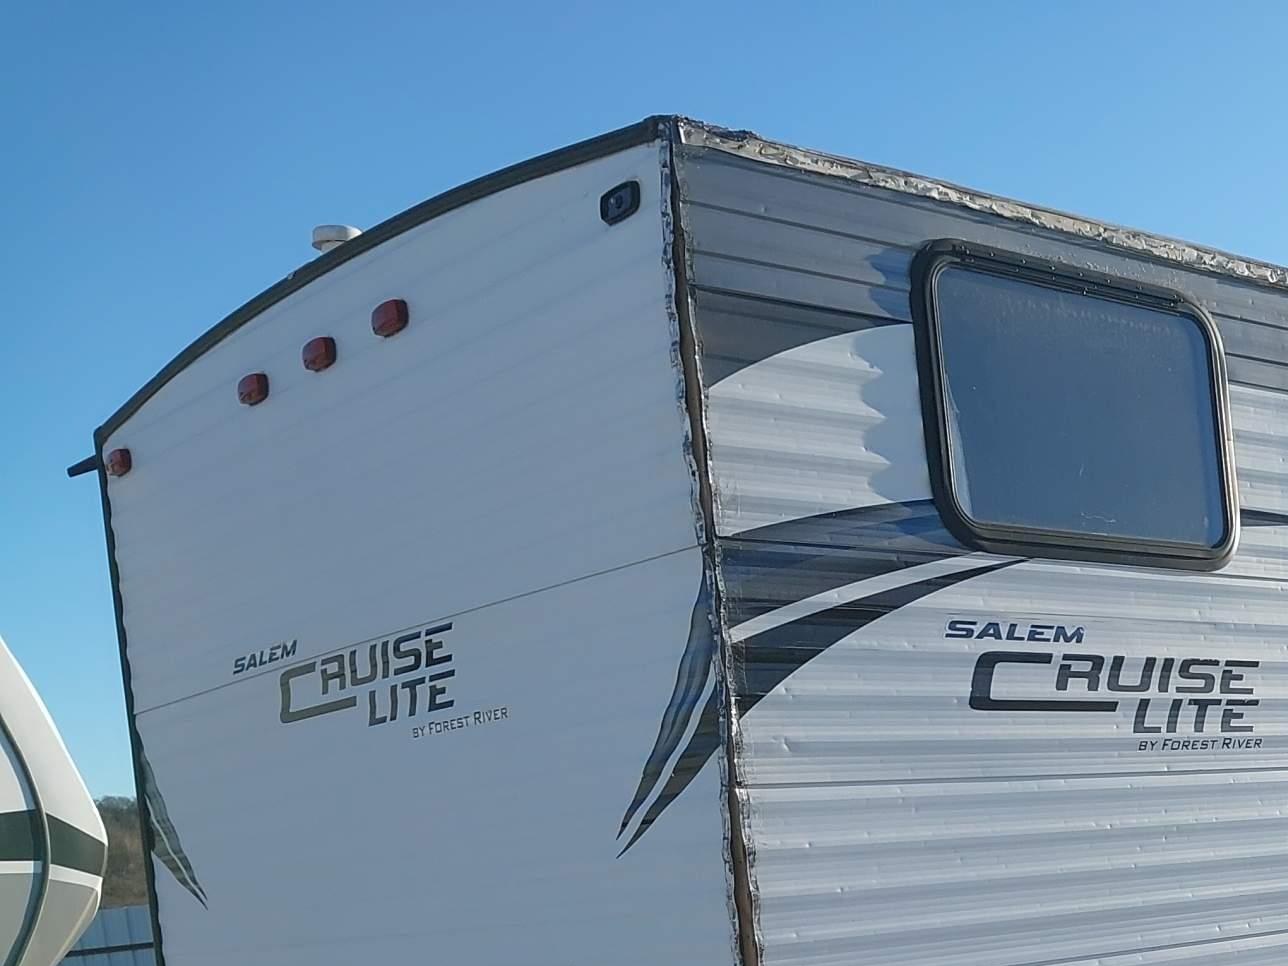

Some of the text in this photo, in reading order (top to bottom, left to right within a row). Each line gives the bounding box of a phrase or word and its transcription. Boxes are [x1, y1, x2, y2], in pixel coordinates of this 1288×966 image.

[945, 620, 1085, 644] SALEM
[233, 639, 298, 675] SALEM
[279, 622, 454, 724] CRUISE
[367, 669, 456, 727] LITE
[968, 651, 1261, 712] CRUISE
[412, 707, 510, 739] BY FOREST RIVER
[1132, 697, 1261, 734] LITE
[1138, 737, 1264, 752] BY FOREST RIVER
